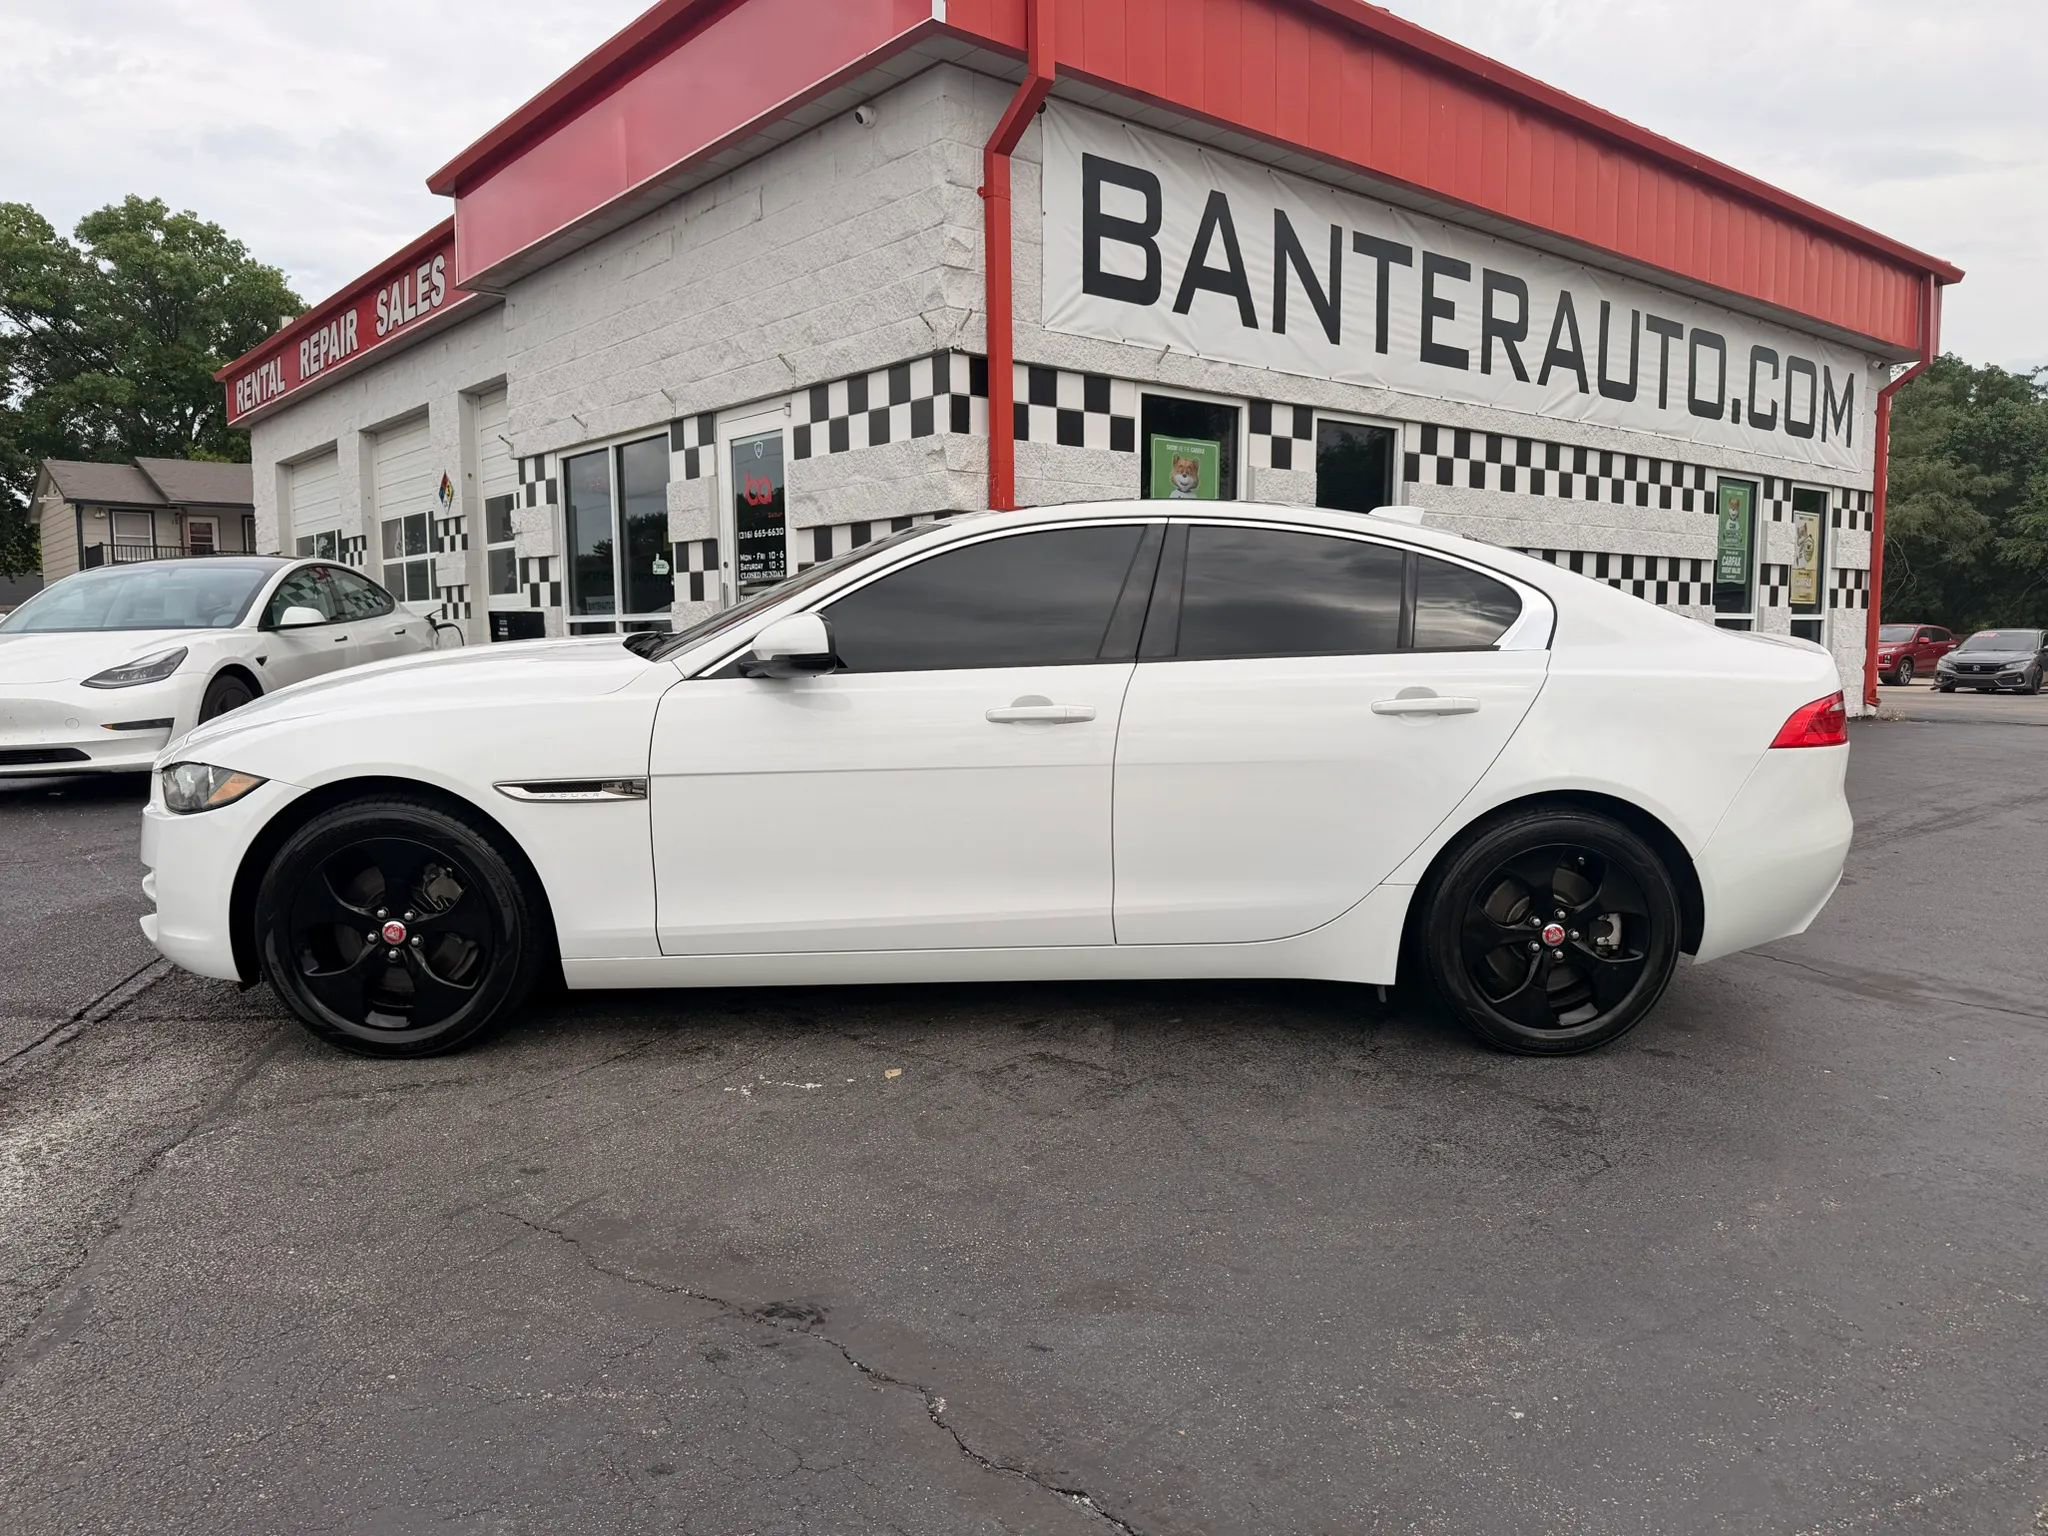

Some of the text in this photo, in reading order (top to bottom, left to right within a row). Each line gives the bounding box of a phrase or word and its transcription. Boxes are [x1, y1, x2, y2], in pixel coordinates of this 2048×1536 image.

[1082, 152, 1855, 449] BANTERAUTO.COM
[235, 255, 446, 415] RENTAL REPAIR SALES
[753, 528, 784, 538] 665-6630
[1721, 555, 1742, 567] CARFAX
[740, 569, 785, 580] CLOSED SUNDAY
